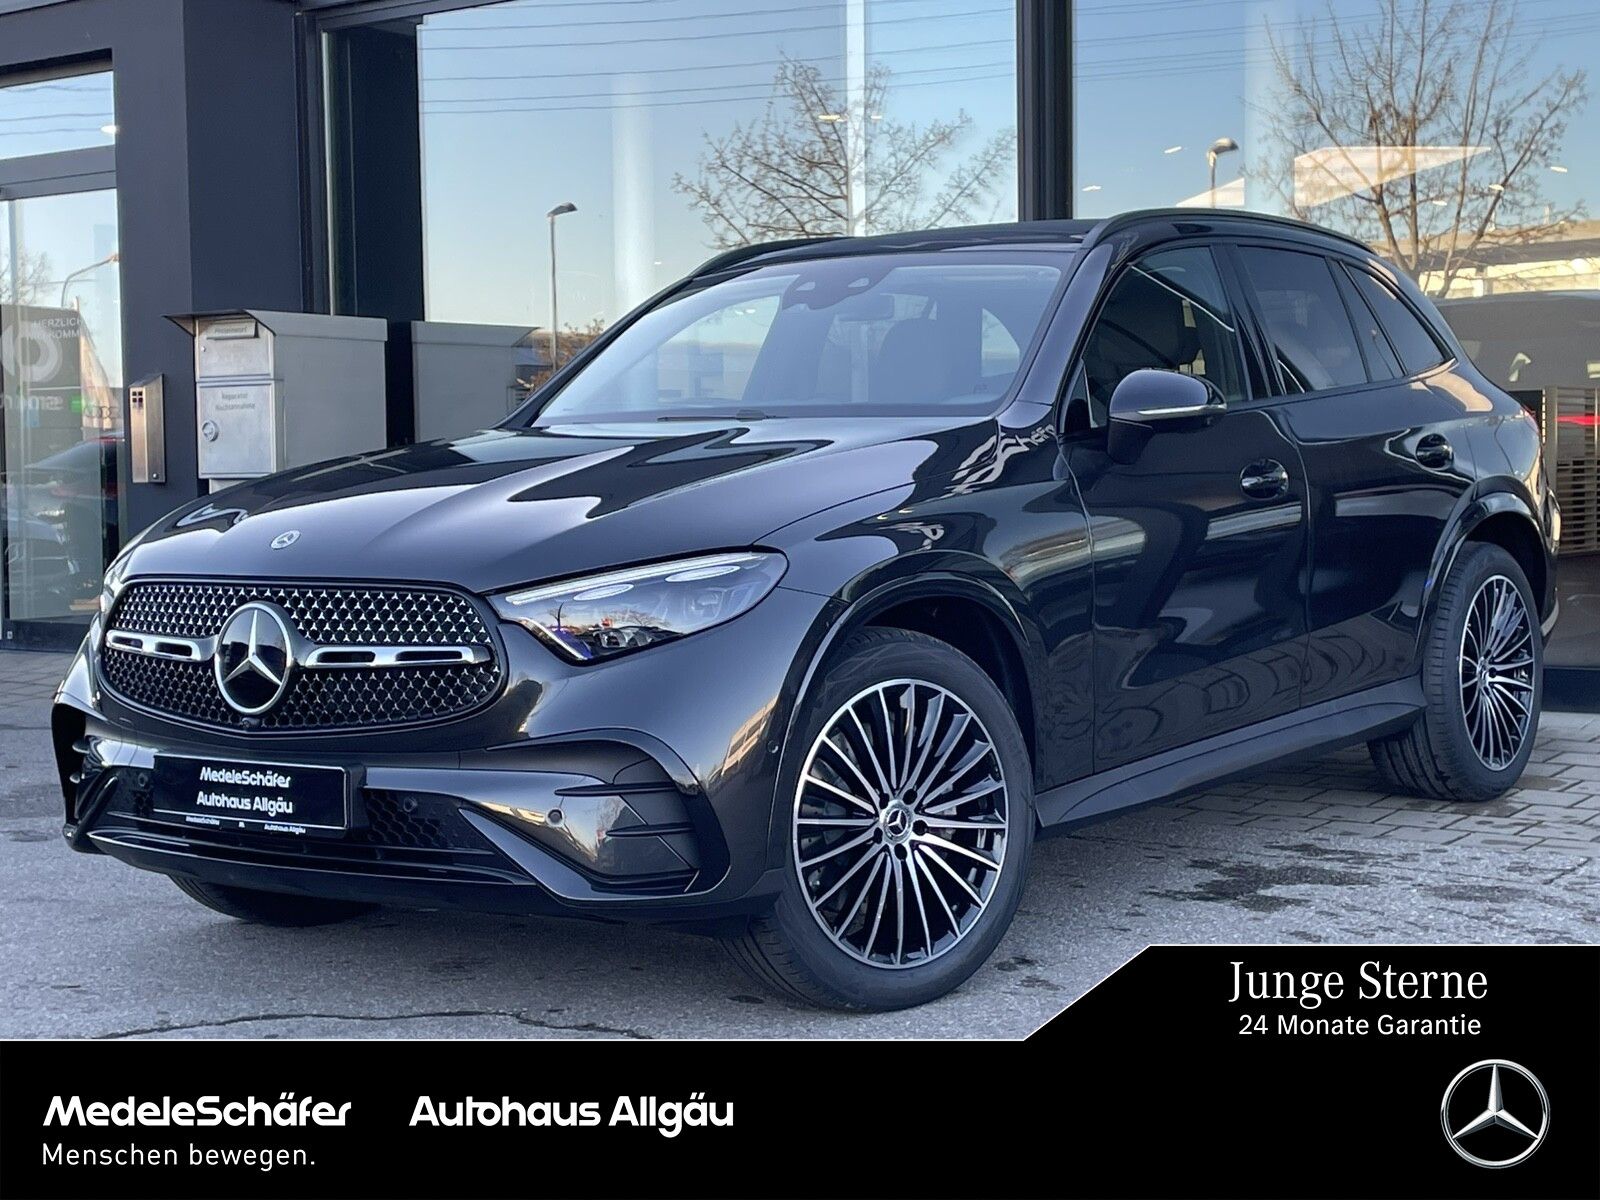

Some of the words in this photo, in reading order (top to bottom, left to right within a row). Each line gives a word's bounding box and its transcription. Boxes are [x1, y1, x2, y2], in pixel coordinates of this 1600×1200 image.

[199, 766, 291, 788] MedeleSchäfer
[196, 791, 251, 810] Autohaus
[252, 796, 293, 817] Allgäu
